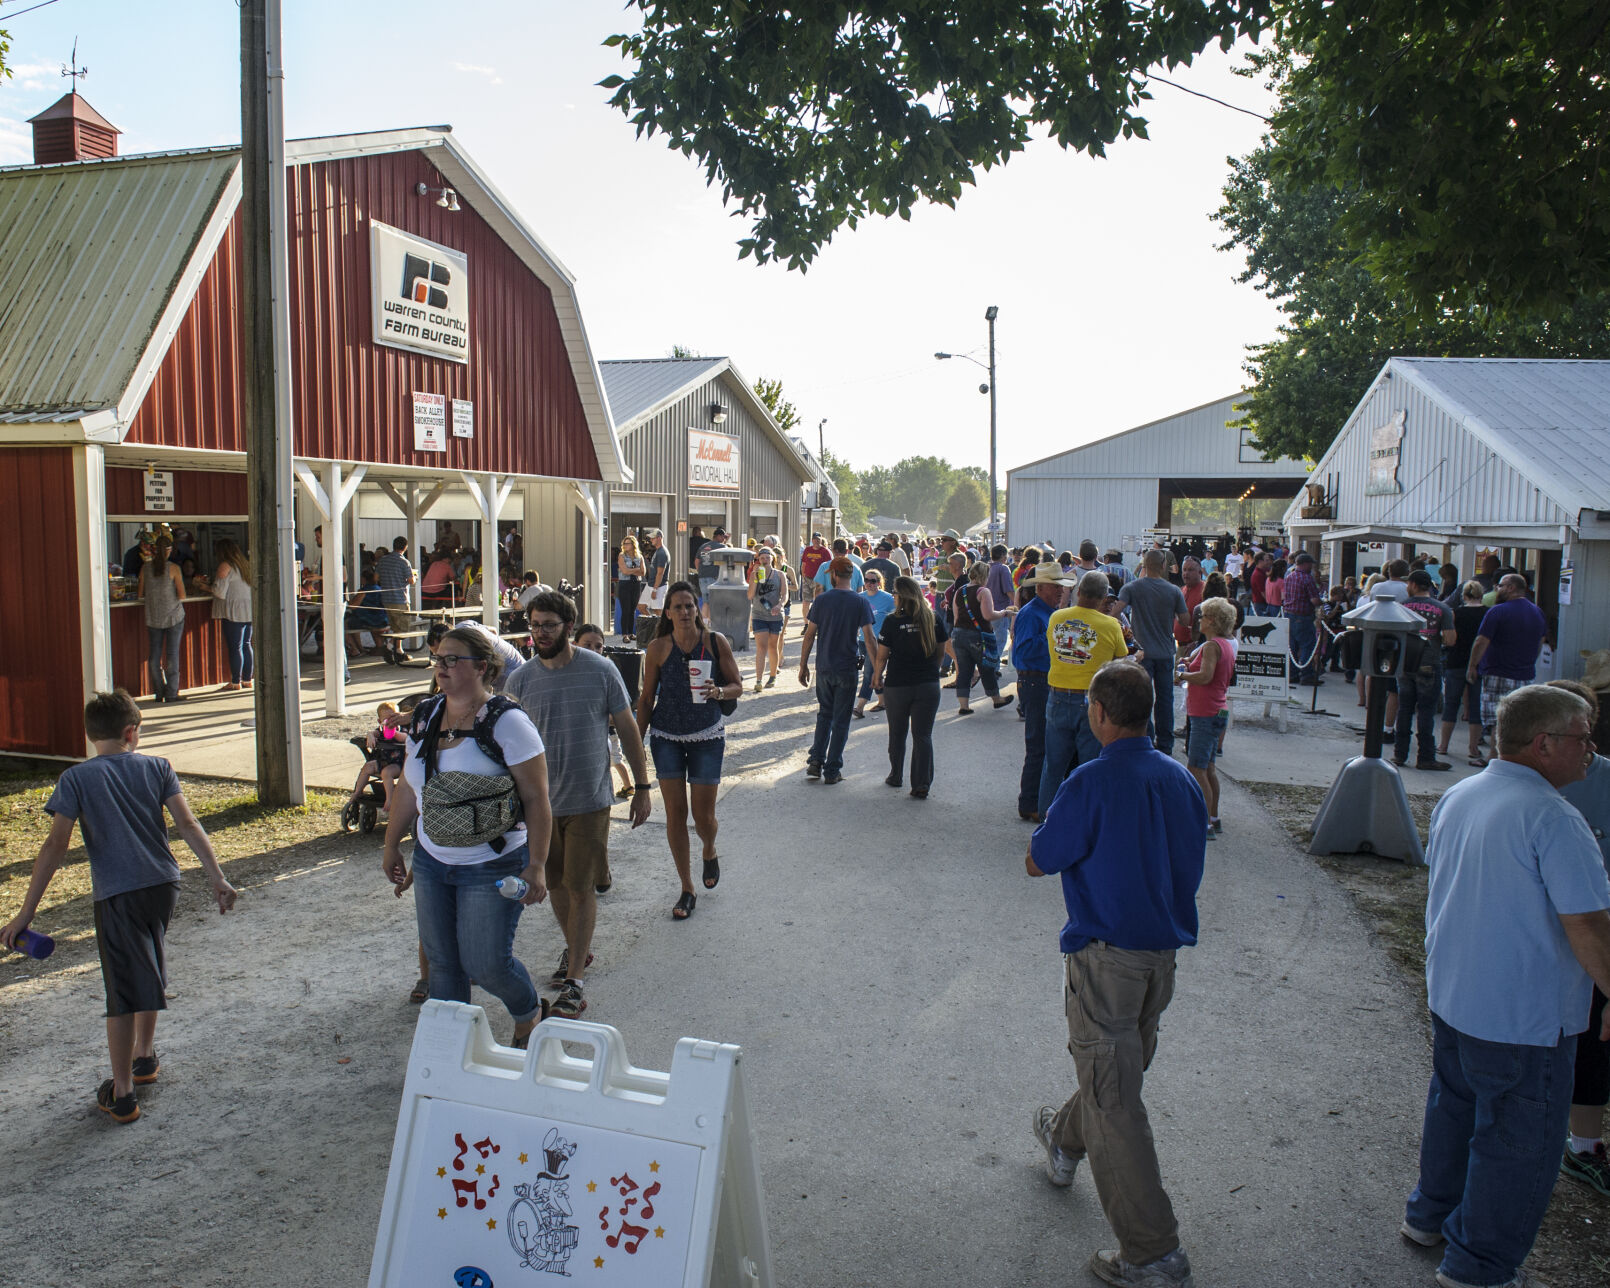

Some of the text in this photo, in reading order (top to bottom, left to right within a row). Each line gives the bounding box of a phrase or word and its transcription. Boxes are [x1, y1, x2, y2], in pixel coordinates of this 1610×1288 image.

[429, 313, 466, 333] county
[385, 319, 466, 348] Farm Bureau
[414, 394, 432, 403] SATURDAY
[434, 396, 444, 405] ONLY
[415, 406, 427, 414] BACK
[429, 407, 443, 416] ALLEY
[415, 416, 445, 426] SMOKEHOUSE
[696, 439, 732, 463] McConnell
[690, 464, 738, 483] MEMORIAL HALL
[678, 521, 687, 531] ATM
